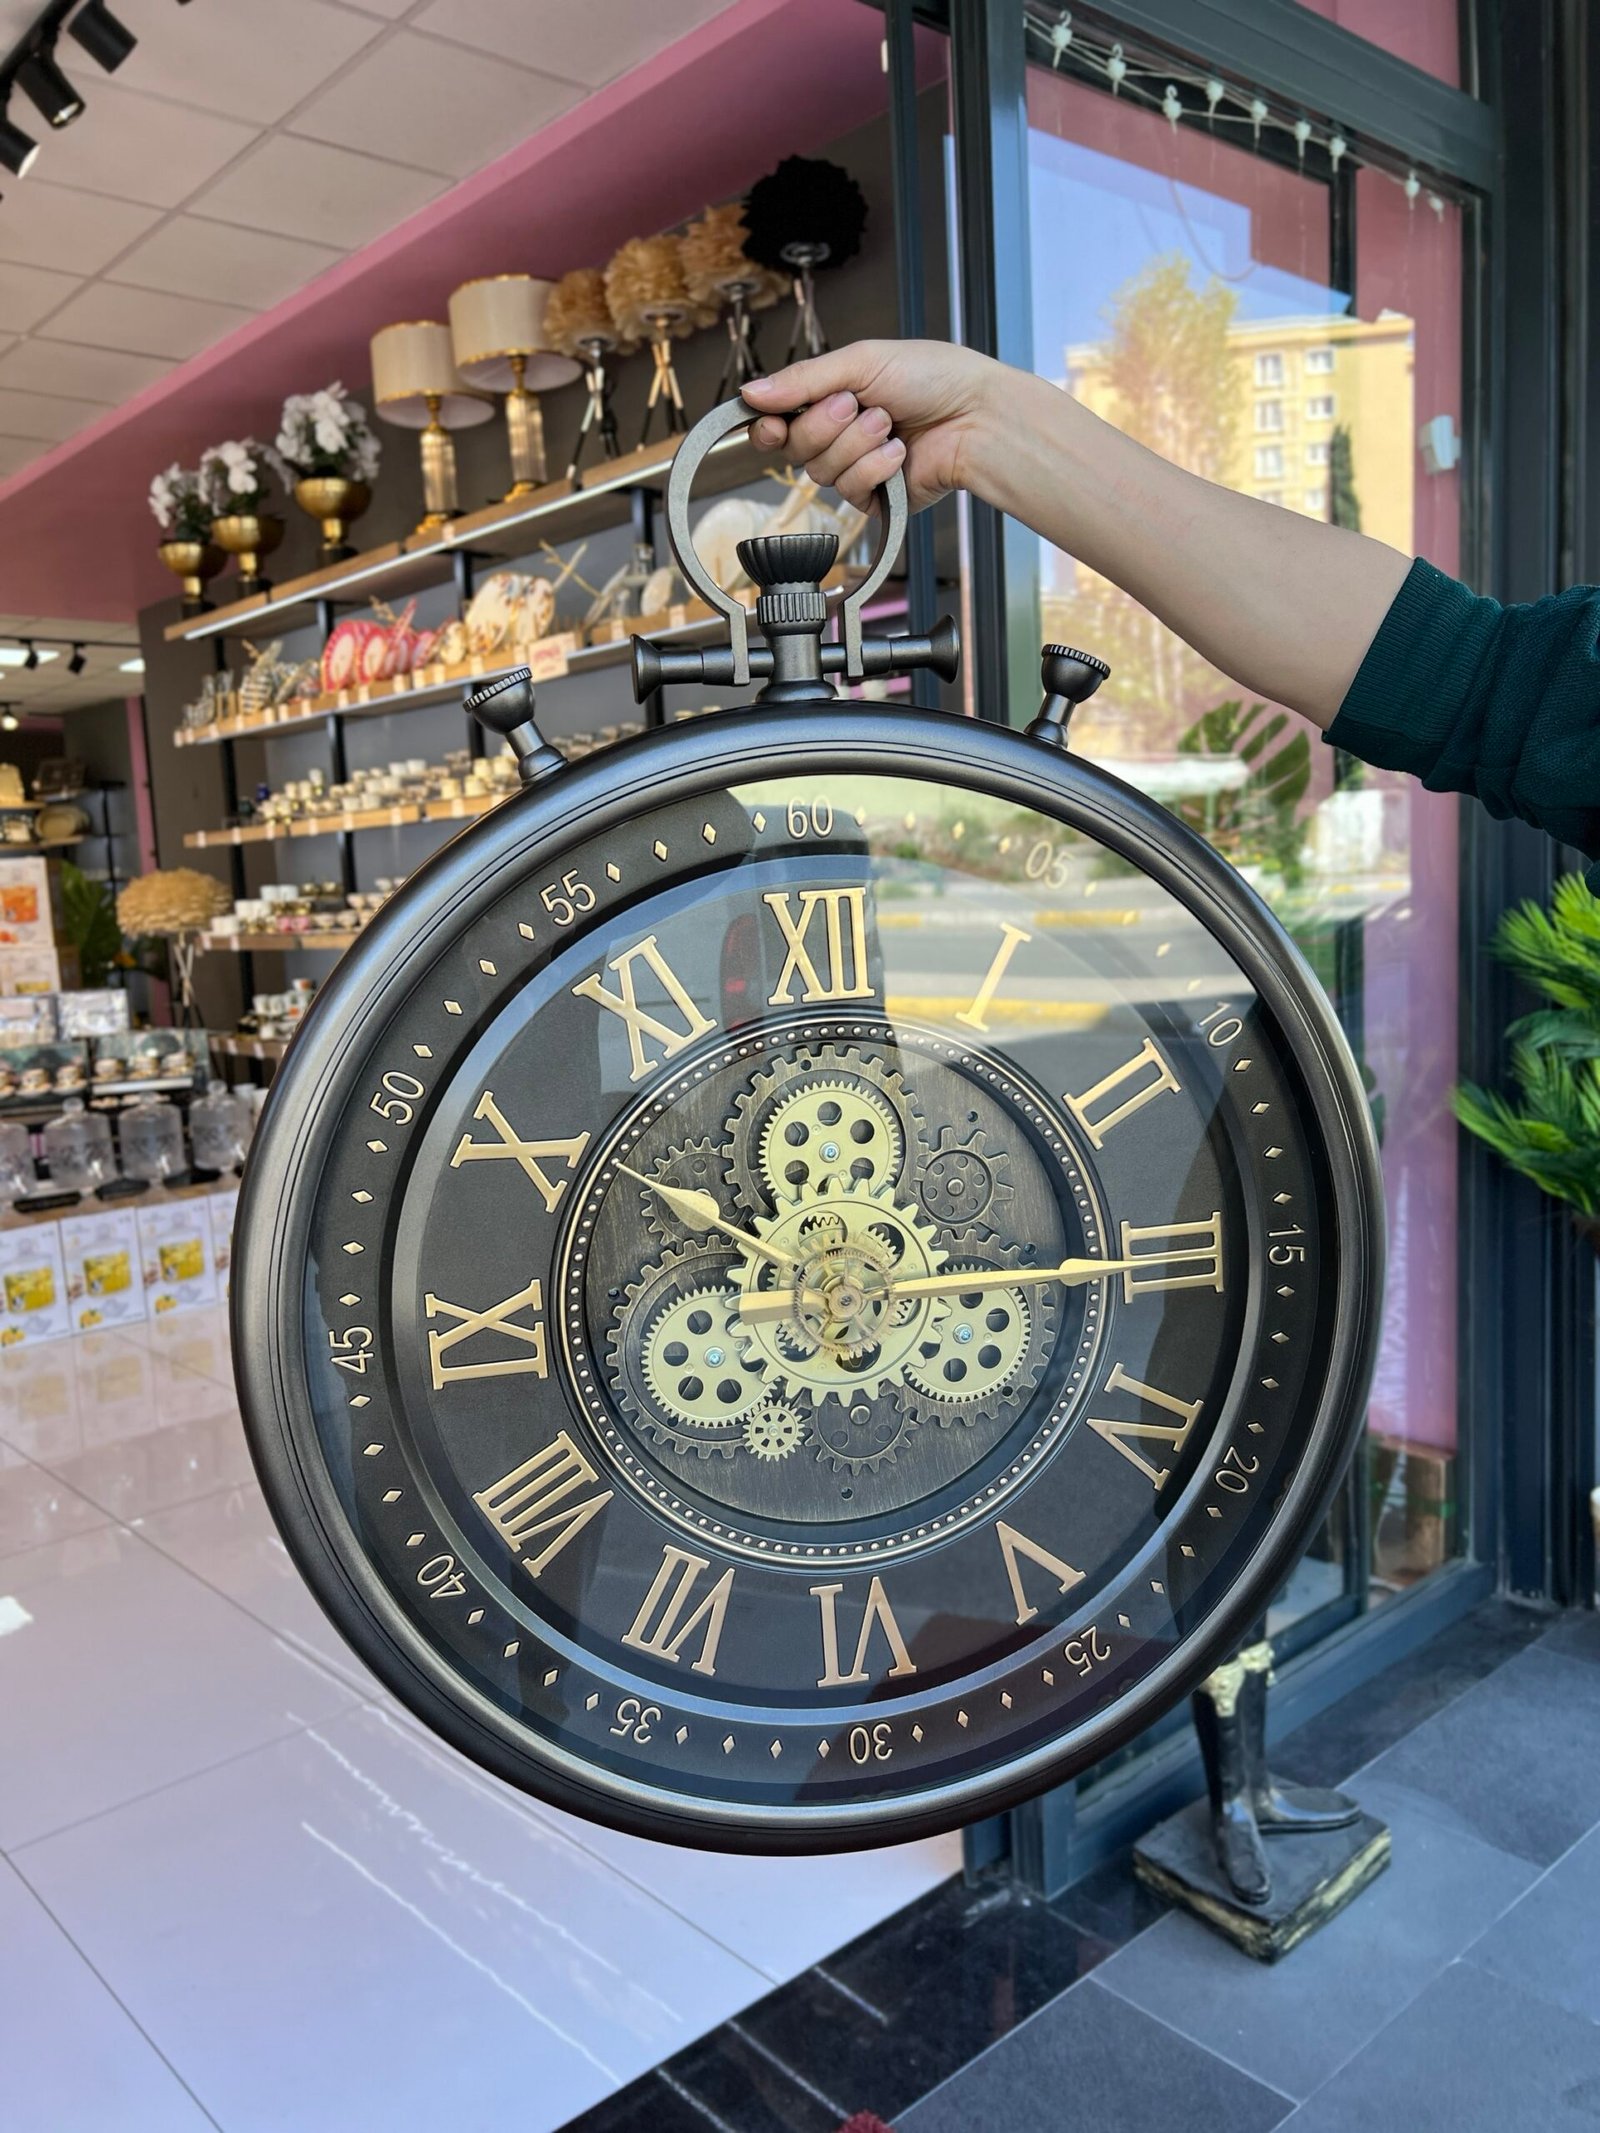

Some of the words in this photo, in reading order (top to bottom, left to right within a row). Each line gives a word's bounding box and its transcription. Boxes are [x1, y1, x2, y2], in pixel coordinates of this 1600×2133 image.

[785, 794, 834, 839] 60
[539, 869, 597, 926] 55
[1024, 840, 1073, 890] 05
[763, 886, 875, 1005] XII
[955, 922, 1032, 1032] I
[572, 934, 717, 1082] XI
[1199, 1001, 1243, 1048] 10
[369, 1069, 426, 1126] 50
[1062, 1036, 1182, 1150] II
[450, 1090, 591, 1213] X
[1120, 1211, 1224, 1304] III
[1266, 1223, 1306, 1264] 15
[328, 1326, 374, 1375] 45
[424, 1278, 548, 1391] IX
[1086, 1361, 1204, 1493] IV
[471, 1429, 615, 1579] VIII
[1214, 1445, 1260, 1495] 20
[415, 1554, 467, 1599] 40
[620, 1543, 736, 1677] VII
[994, 1520, 1087, 1626] V
[808, 1576, 917, 1688] VI
[1063, 1625, 1113, 1678] 25
[608, 1698, 663, 1746] 35
[847, 1724, 894, 1766] 30
